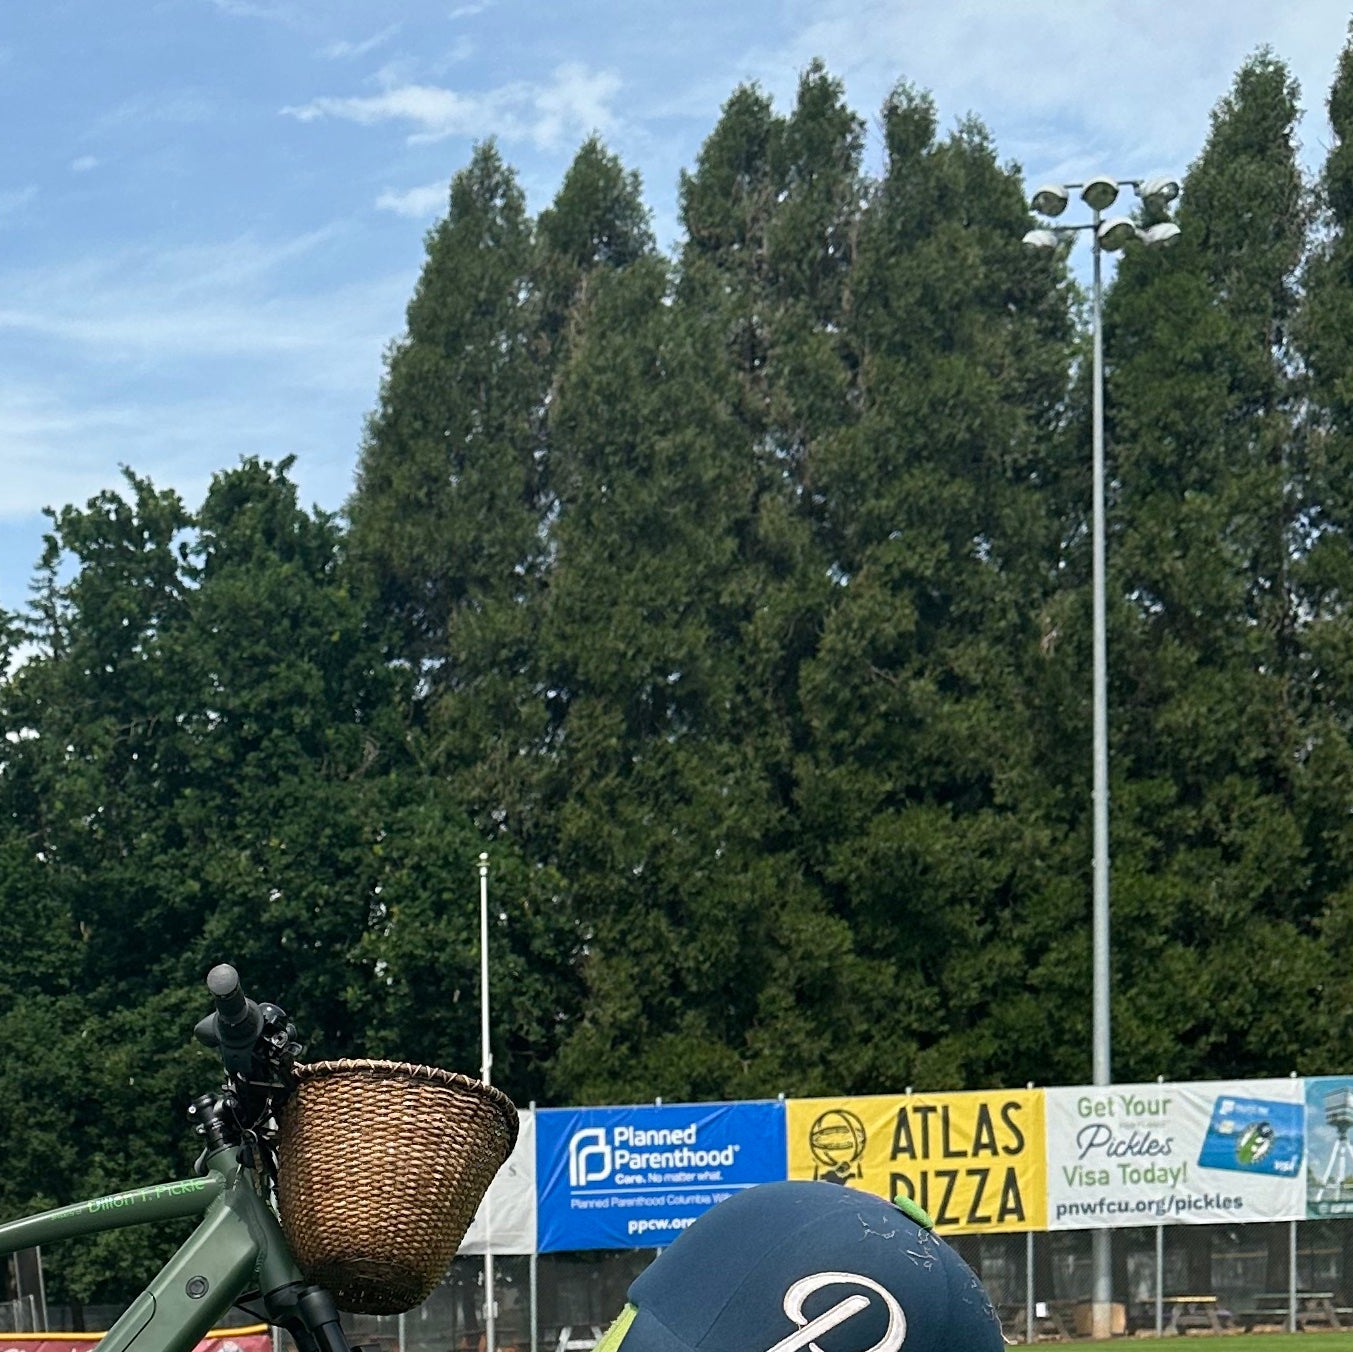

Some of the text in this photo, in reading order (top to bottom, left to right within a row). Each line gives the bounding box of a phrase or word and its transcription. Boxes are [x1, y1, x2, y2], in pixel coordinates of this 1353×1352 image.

[1077, 1094, 1172, 1118] Get Your
[613, 1122, 697, 1147] Planned
[889, 1101, 1026, 1161] ATLAS
[1076, 1122, 1174, 1161] Pickles
[614, 1172, 647, 1185] Care.
[1062, 1161, 1188, 1189] Visa Today!
[1056, 1193, 1244, 1220] pnwfcu.org/pickles
[627, 1216, 698, 1236] ppcw.or
